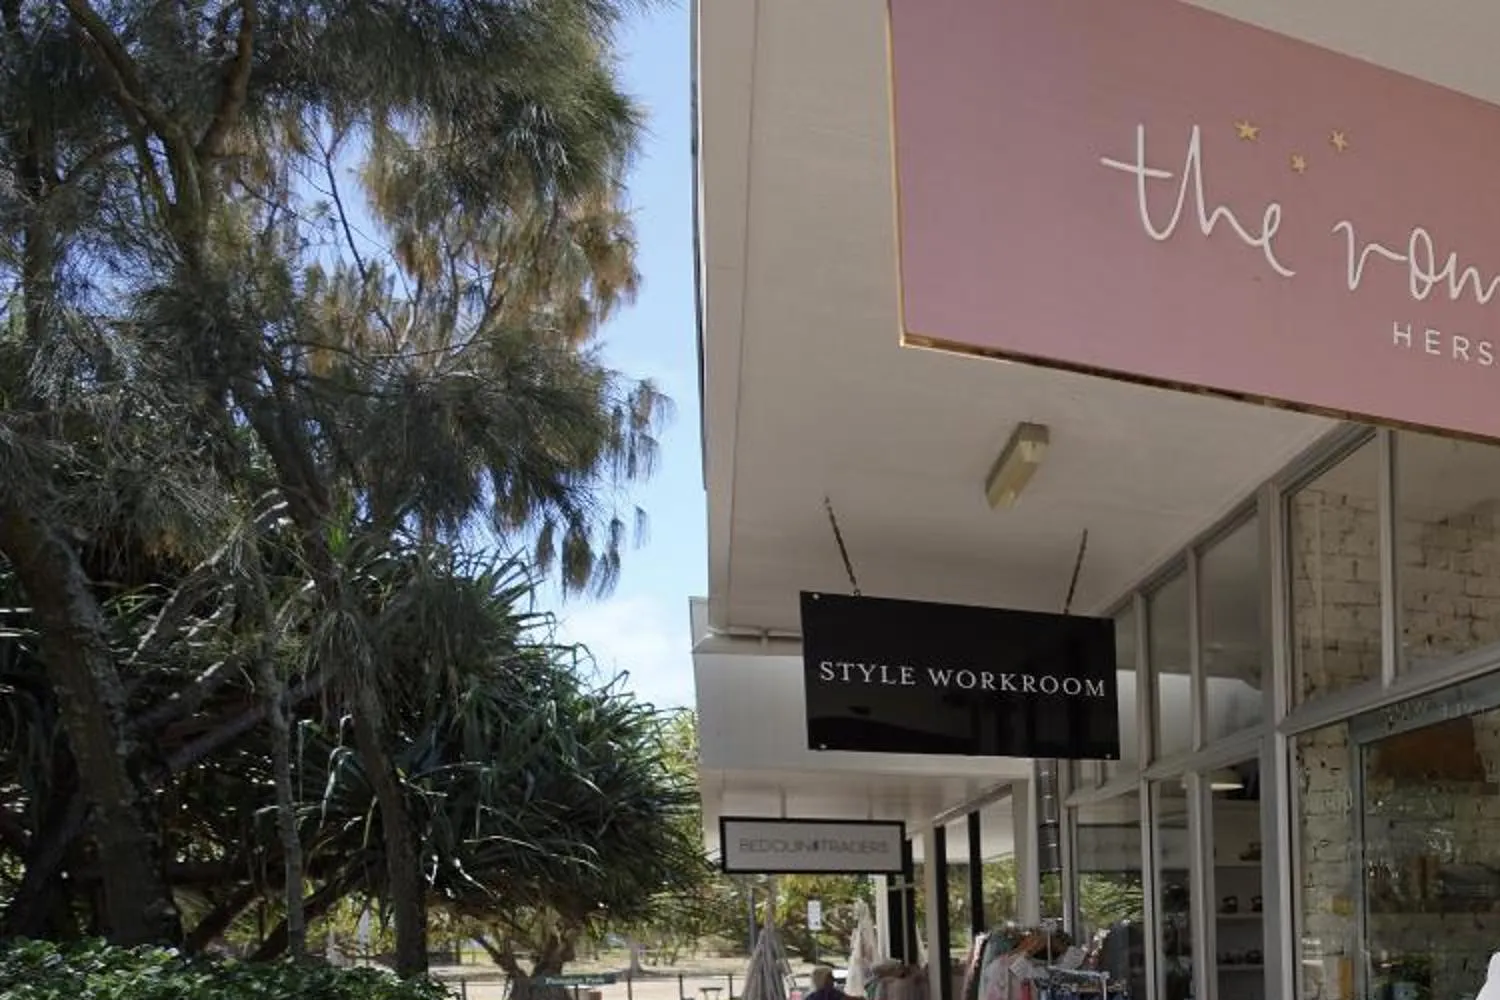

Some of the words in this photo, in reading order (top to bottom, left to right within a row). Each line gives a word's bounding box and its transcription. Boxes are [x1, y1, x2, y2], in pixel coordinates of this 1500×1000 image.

[1100, 123, 1297, 278] the
[1392, 320, 1494, 366] HERS
[819, 660, 917, 686] STYLE
[927, 667, 1106, 698] WORKROOM
